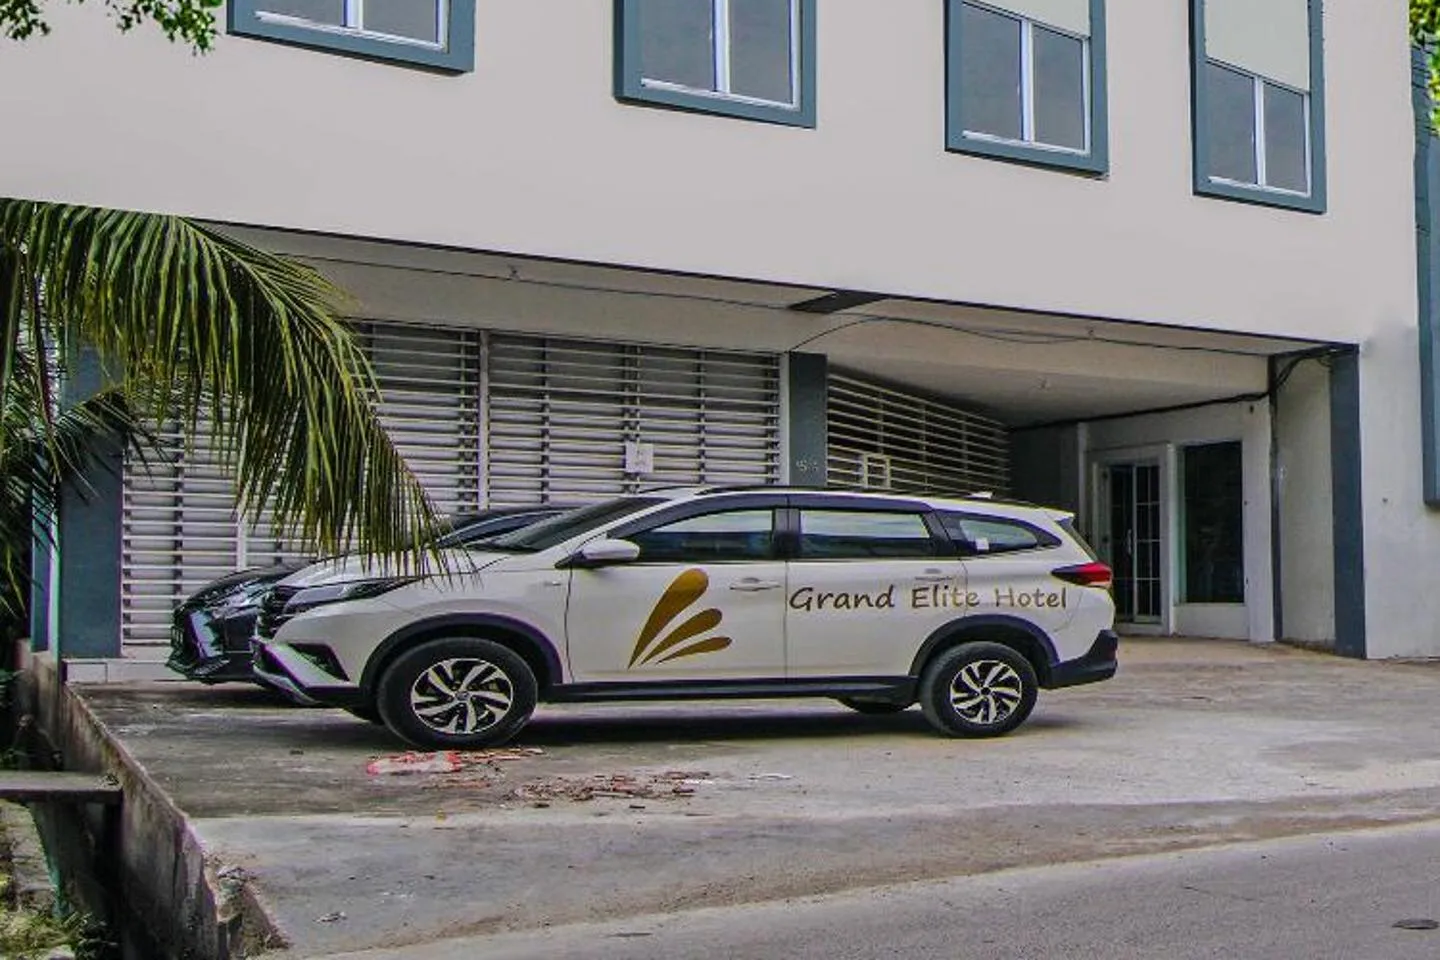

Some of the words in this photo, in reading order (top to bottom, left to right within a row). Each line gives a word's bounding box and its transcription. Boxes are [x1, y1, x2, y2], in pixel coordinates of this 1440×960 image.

[789, 584, 895, 611] Grand
[911, 584, 980, 609] Elite
[995, 588, 1067, 608] Hotel
